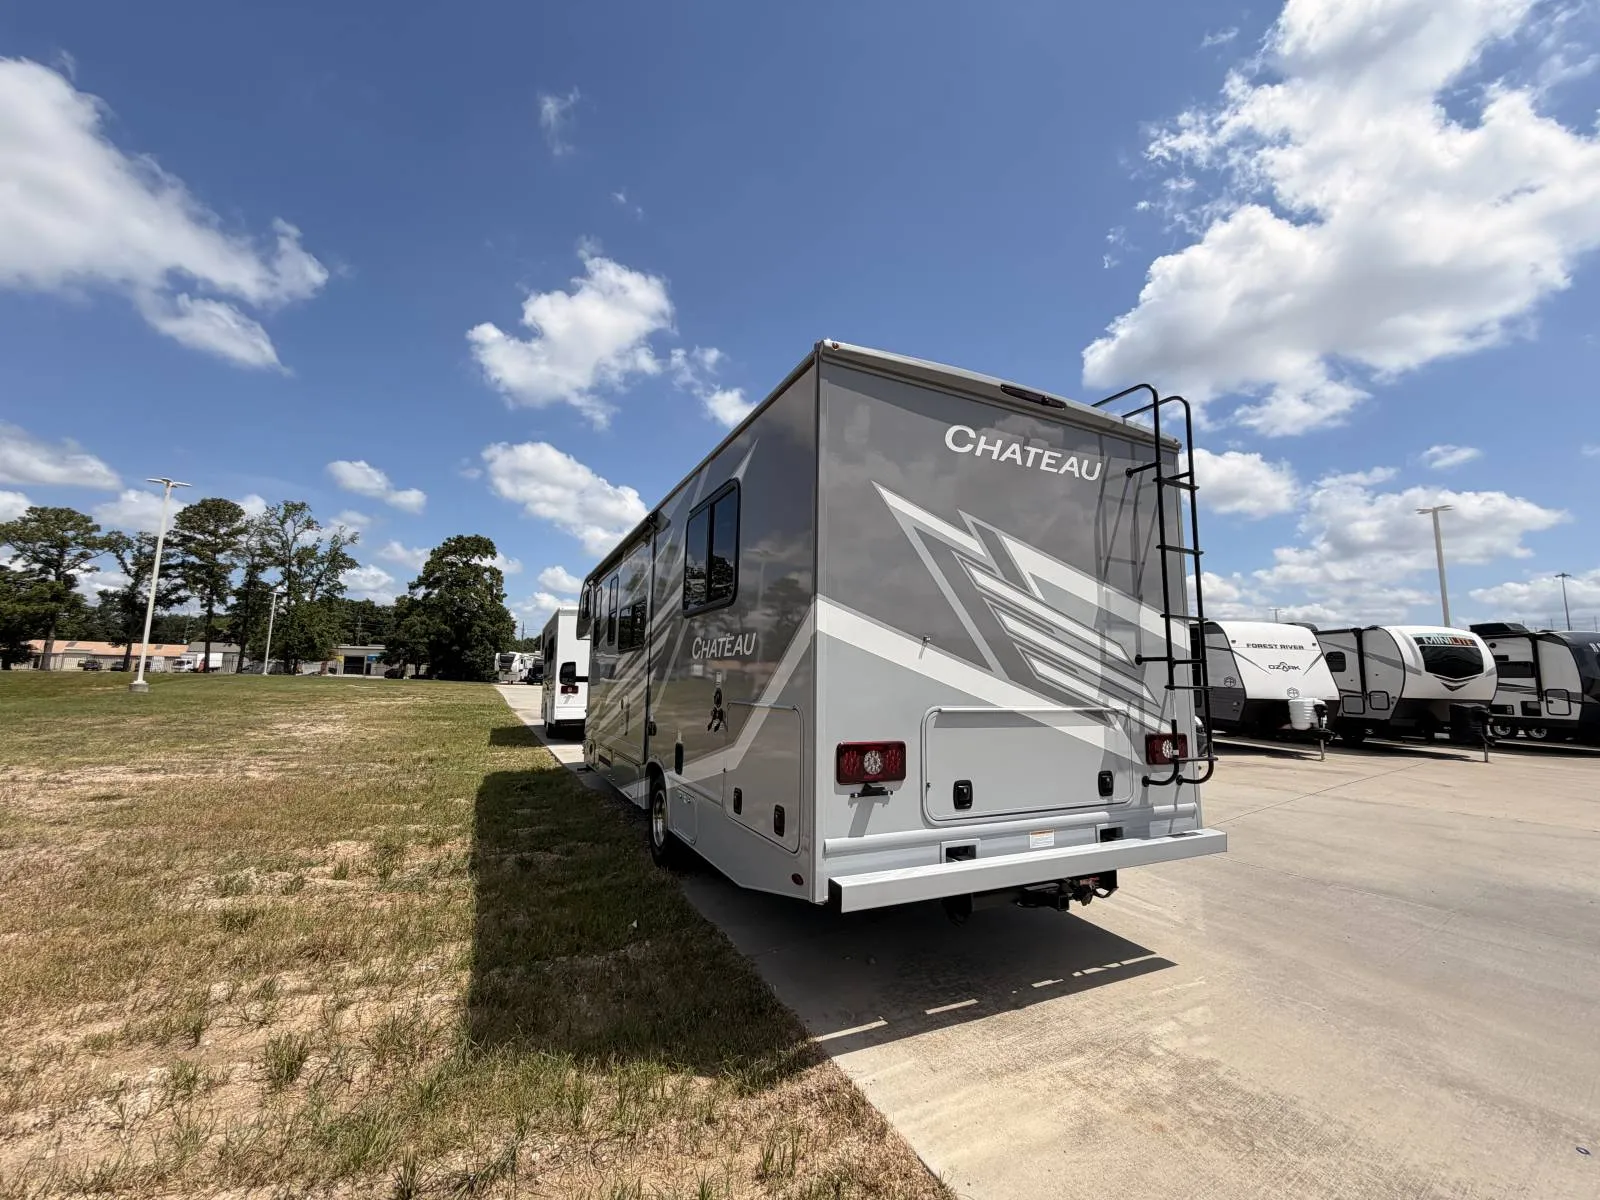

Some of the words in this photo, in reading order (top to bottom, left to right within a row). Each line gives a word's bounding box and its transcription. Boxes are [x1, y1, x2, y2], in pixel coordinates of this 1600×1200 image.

[944, 424, 1102, 481] CHATEAU
[691, 632, 757, 660] CHATEAU
[1268, 661, 1301, 673] OZARK
